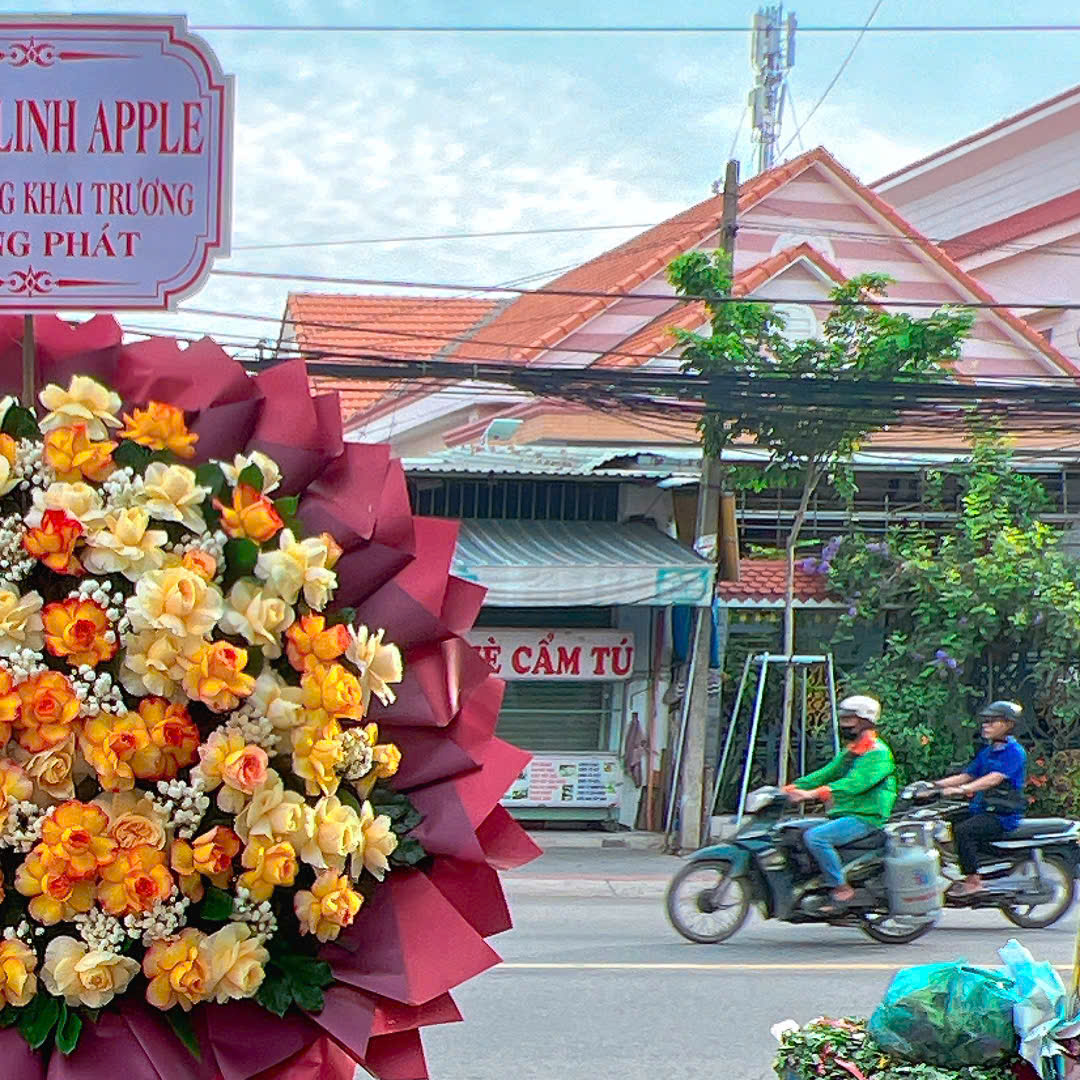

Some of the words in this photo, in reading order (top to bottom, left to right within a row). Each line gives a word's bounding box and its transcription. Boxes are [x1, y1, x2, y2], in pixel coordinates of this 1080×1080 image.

[88, 99, 204, 156] APPLE
[23, 181, 83, 216] KHAI
[91, 176, 194, 217] TRƯƠNG
[43, 223, 142, 258] PHÁT
[471, 636, 502, 674] È
[511, 632, 581, 676] CẨM
[591, 638, 634, 676] TÚ
